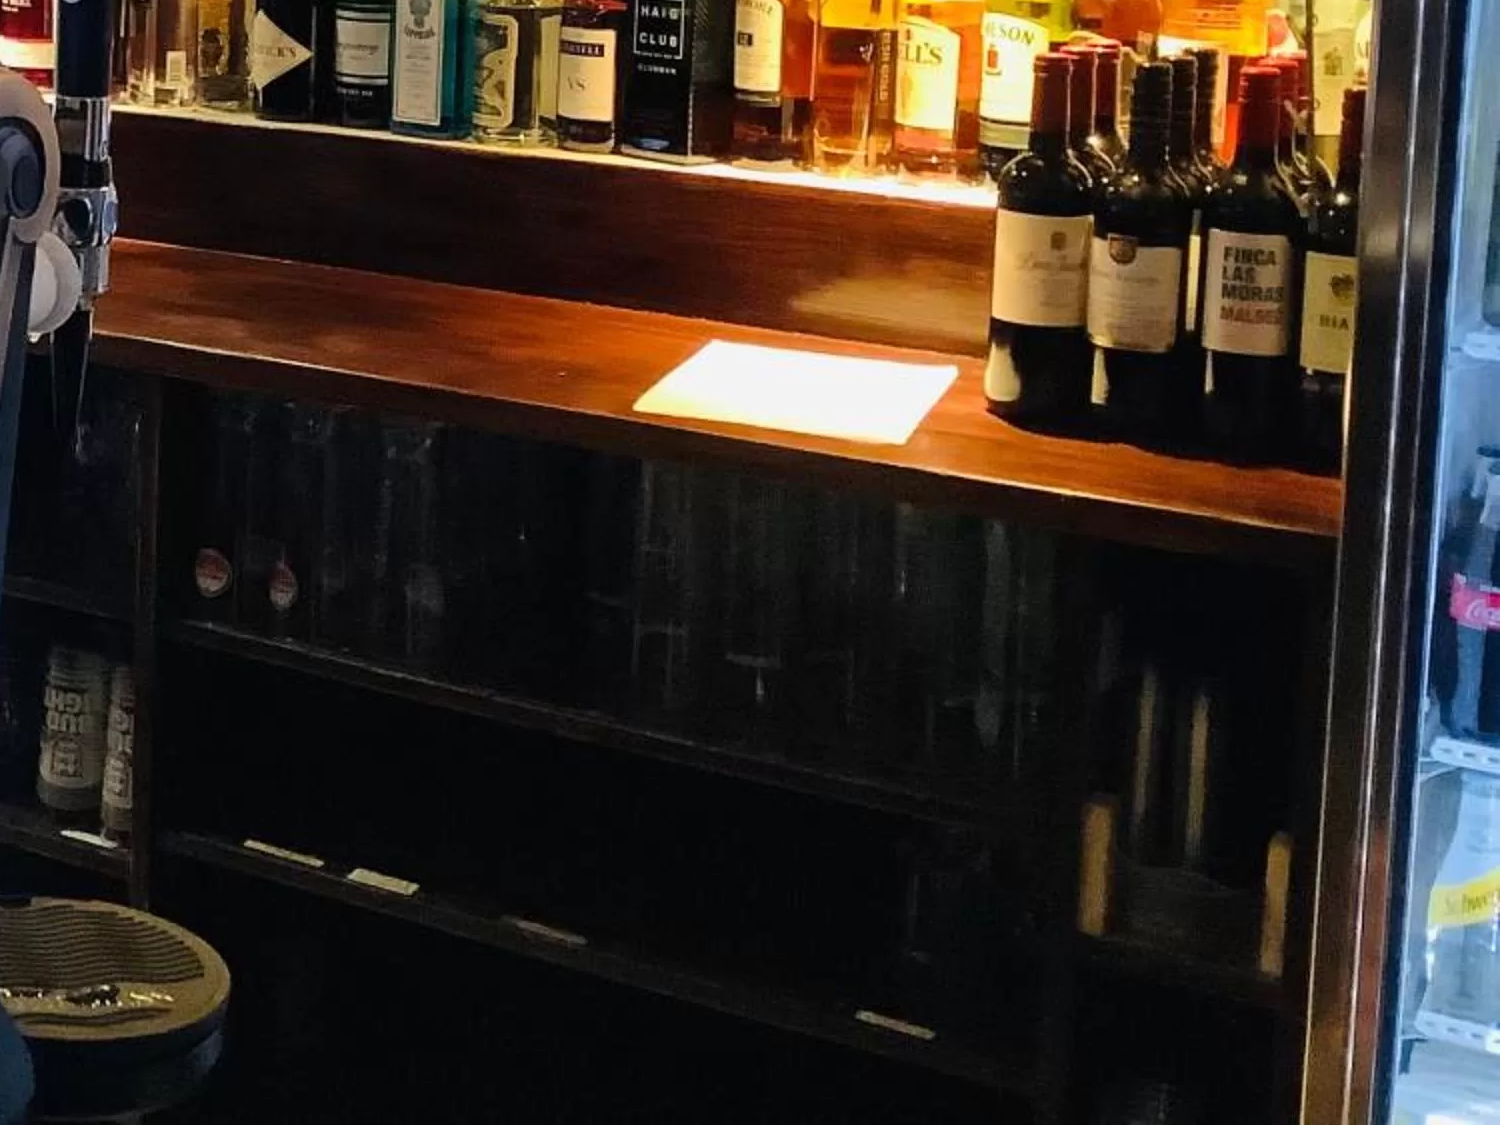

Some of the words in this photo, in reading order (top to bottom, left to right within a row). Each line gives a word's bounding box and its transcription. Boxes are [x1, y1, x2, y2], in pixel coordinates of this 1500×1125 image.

[640, 4, 680, 21] HAIG
[639, 31, 678, 48] CLUB
[1222, 245, 1277, 266] FINCA
[1221, 265, 1256, 283] LAS
